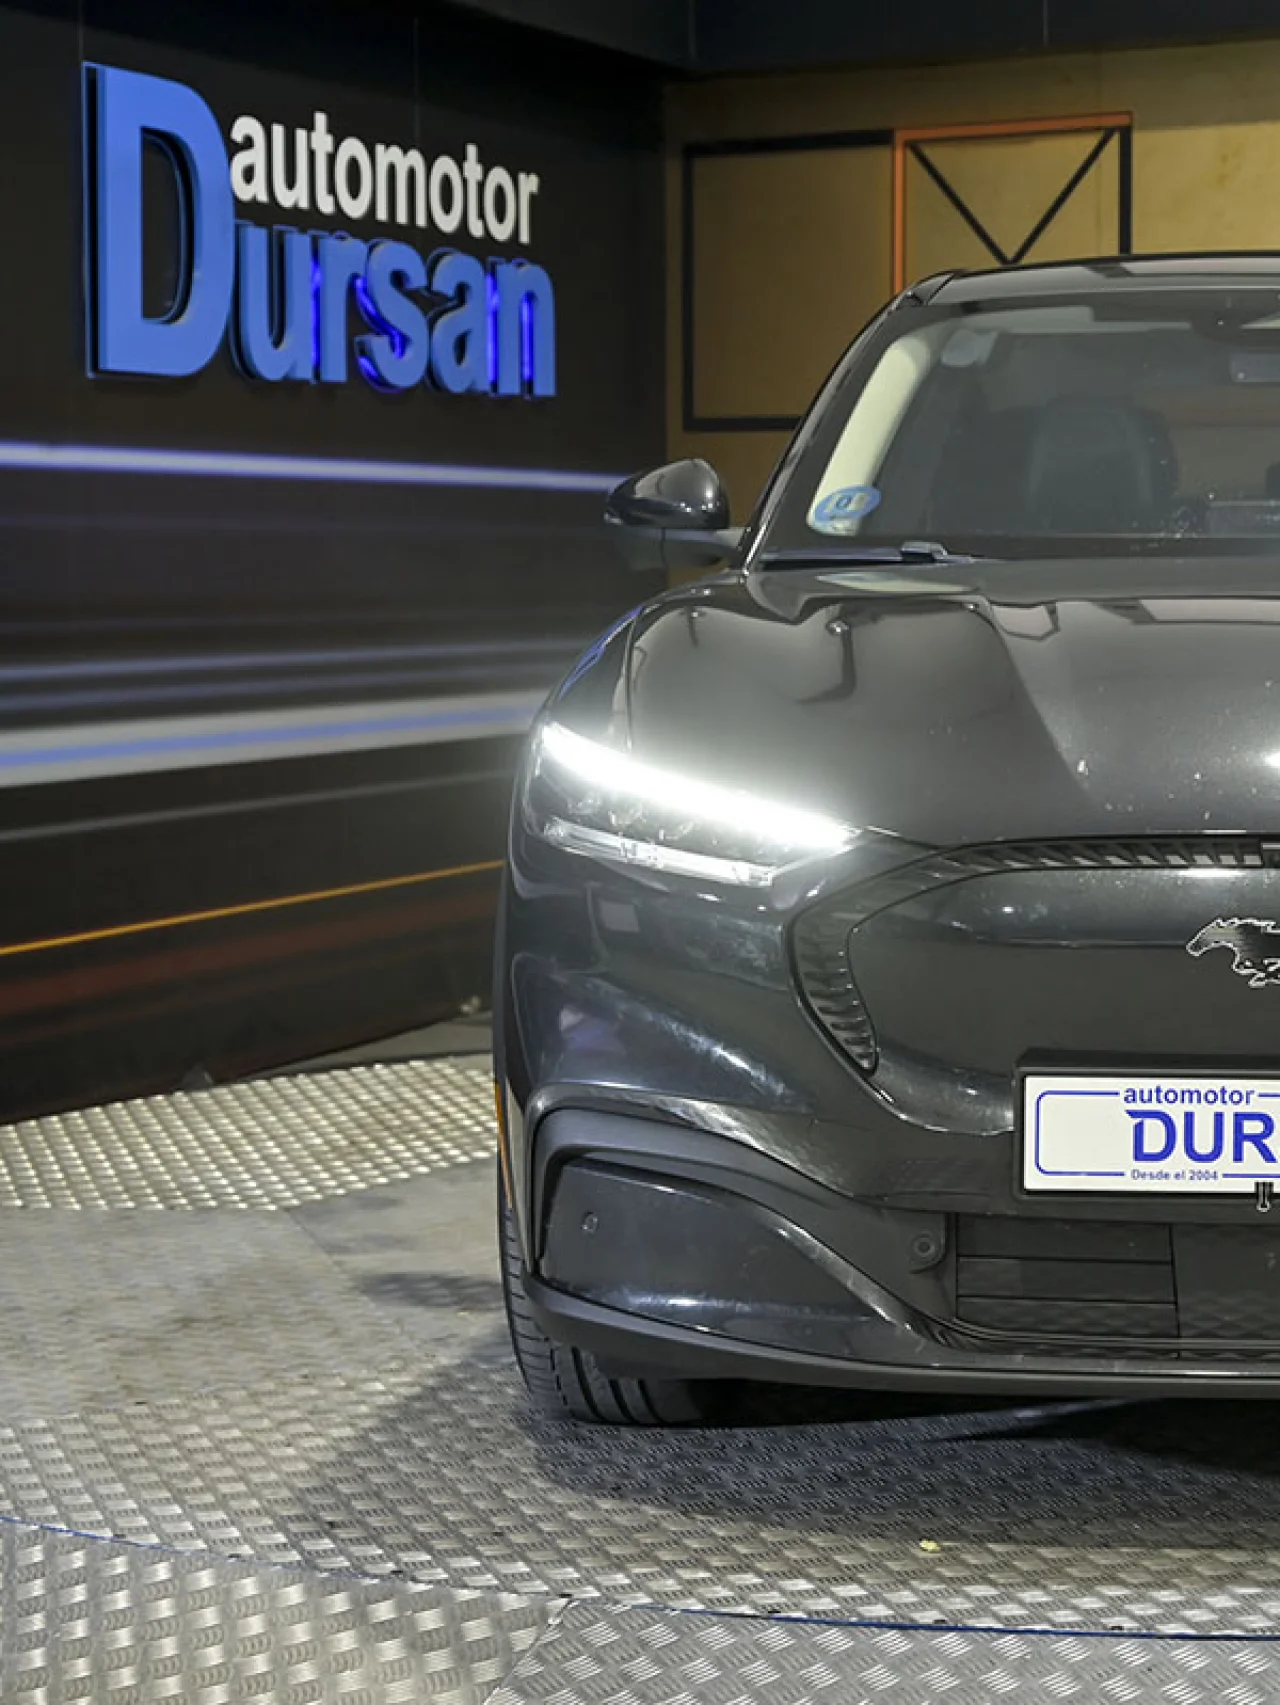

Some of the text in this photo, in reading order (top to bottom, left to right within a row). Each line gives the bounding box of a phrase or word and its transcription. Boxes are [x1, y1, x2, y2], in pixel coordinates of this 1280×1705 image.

[229, 111, 540, 245] automotor
[82, 61, 557, 398] Dursan
[1123, 1085, 1255, 1105] automotor
[1131, 1168, 1219, 1182] Desde el 2004
